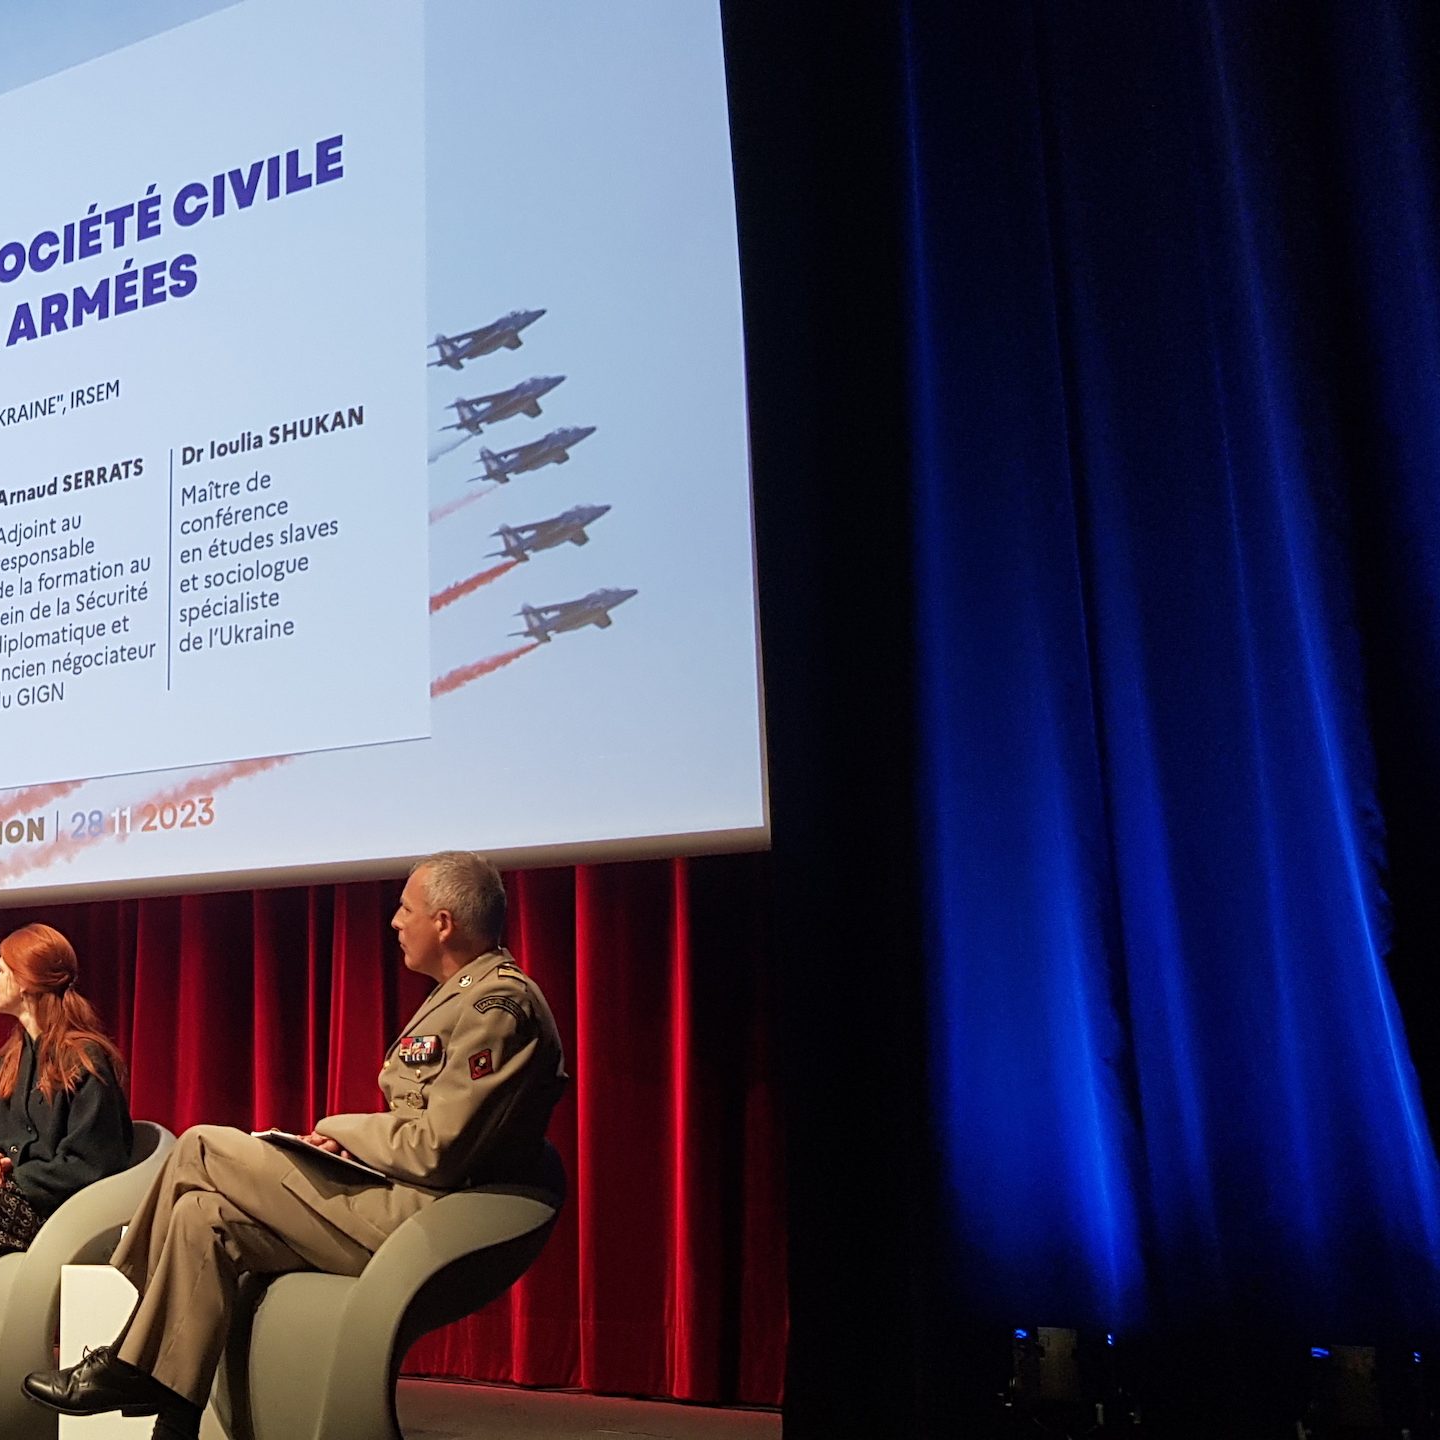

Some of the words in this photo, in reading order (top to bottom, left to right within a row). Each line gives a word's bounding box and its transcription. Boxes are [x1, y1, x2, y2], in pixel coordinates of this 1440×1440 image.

[173, 134, 344, 226] CIVILE
[6, 254, 197, 347] ARMÉES
[71, 380, 120, 409] IRSEM
[182, 446, 204, 466] Dr
[210, 431, 263, 459] Ioulia
[269, 406, 363, 445] SHUKAN
[62, 458, 143, 492] SERRATS
[182, 481, 240, 506] Maître
[246, 470, 271, 491] de
[62, 515, 81, 531] au
[180, 500, 288, 535] conférence
[180, 548, 202, 564] en
[208, 532, 274, 558] études
[280, 520, 338, 545] slaves
[20, 577, 32, 595] la
[38, 561, 124, 592] formation
[130, 557, 150, 573] au
[180, 574, 198, 593] et
[204, 556, 308, 589] sociologue
[30, 601, 51, 620] de
[57, 597, 70, 616] la
[76, 581, 148, 612] Sécurité
[180, 591, 279, 627] spécialiste
[111, 616, 129, 634] et
[179, 633, 202, 652] de
[52, 643, 156, 675] négociateur
[17, 682, 64, 706] GIGN
[70, 810, 105, 838] 28
[110, 808, 134, 836] 11
[140, 796, 216, 832] 2023
